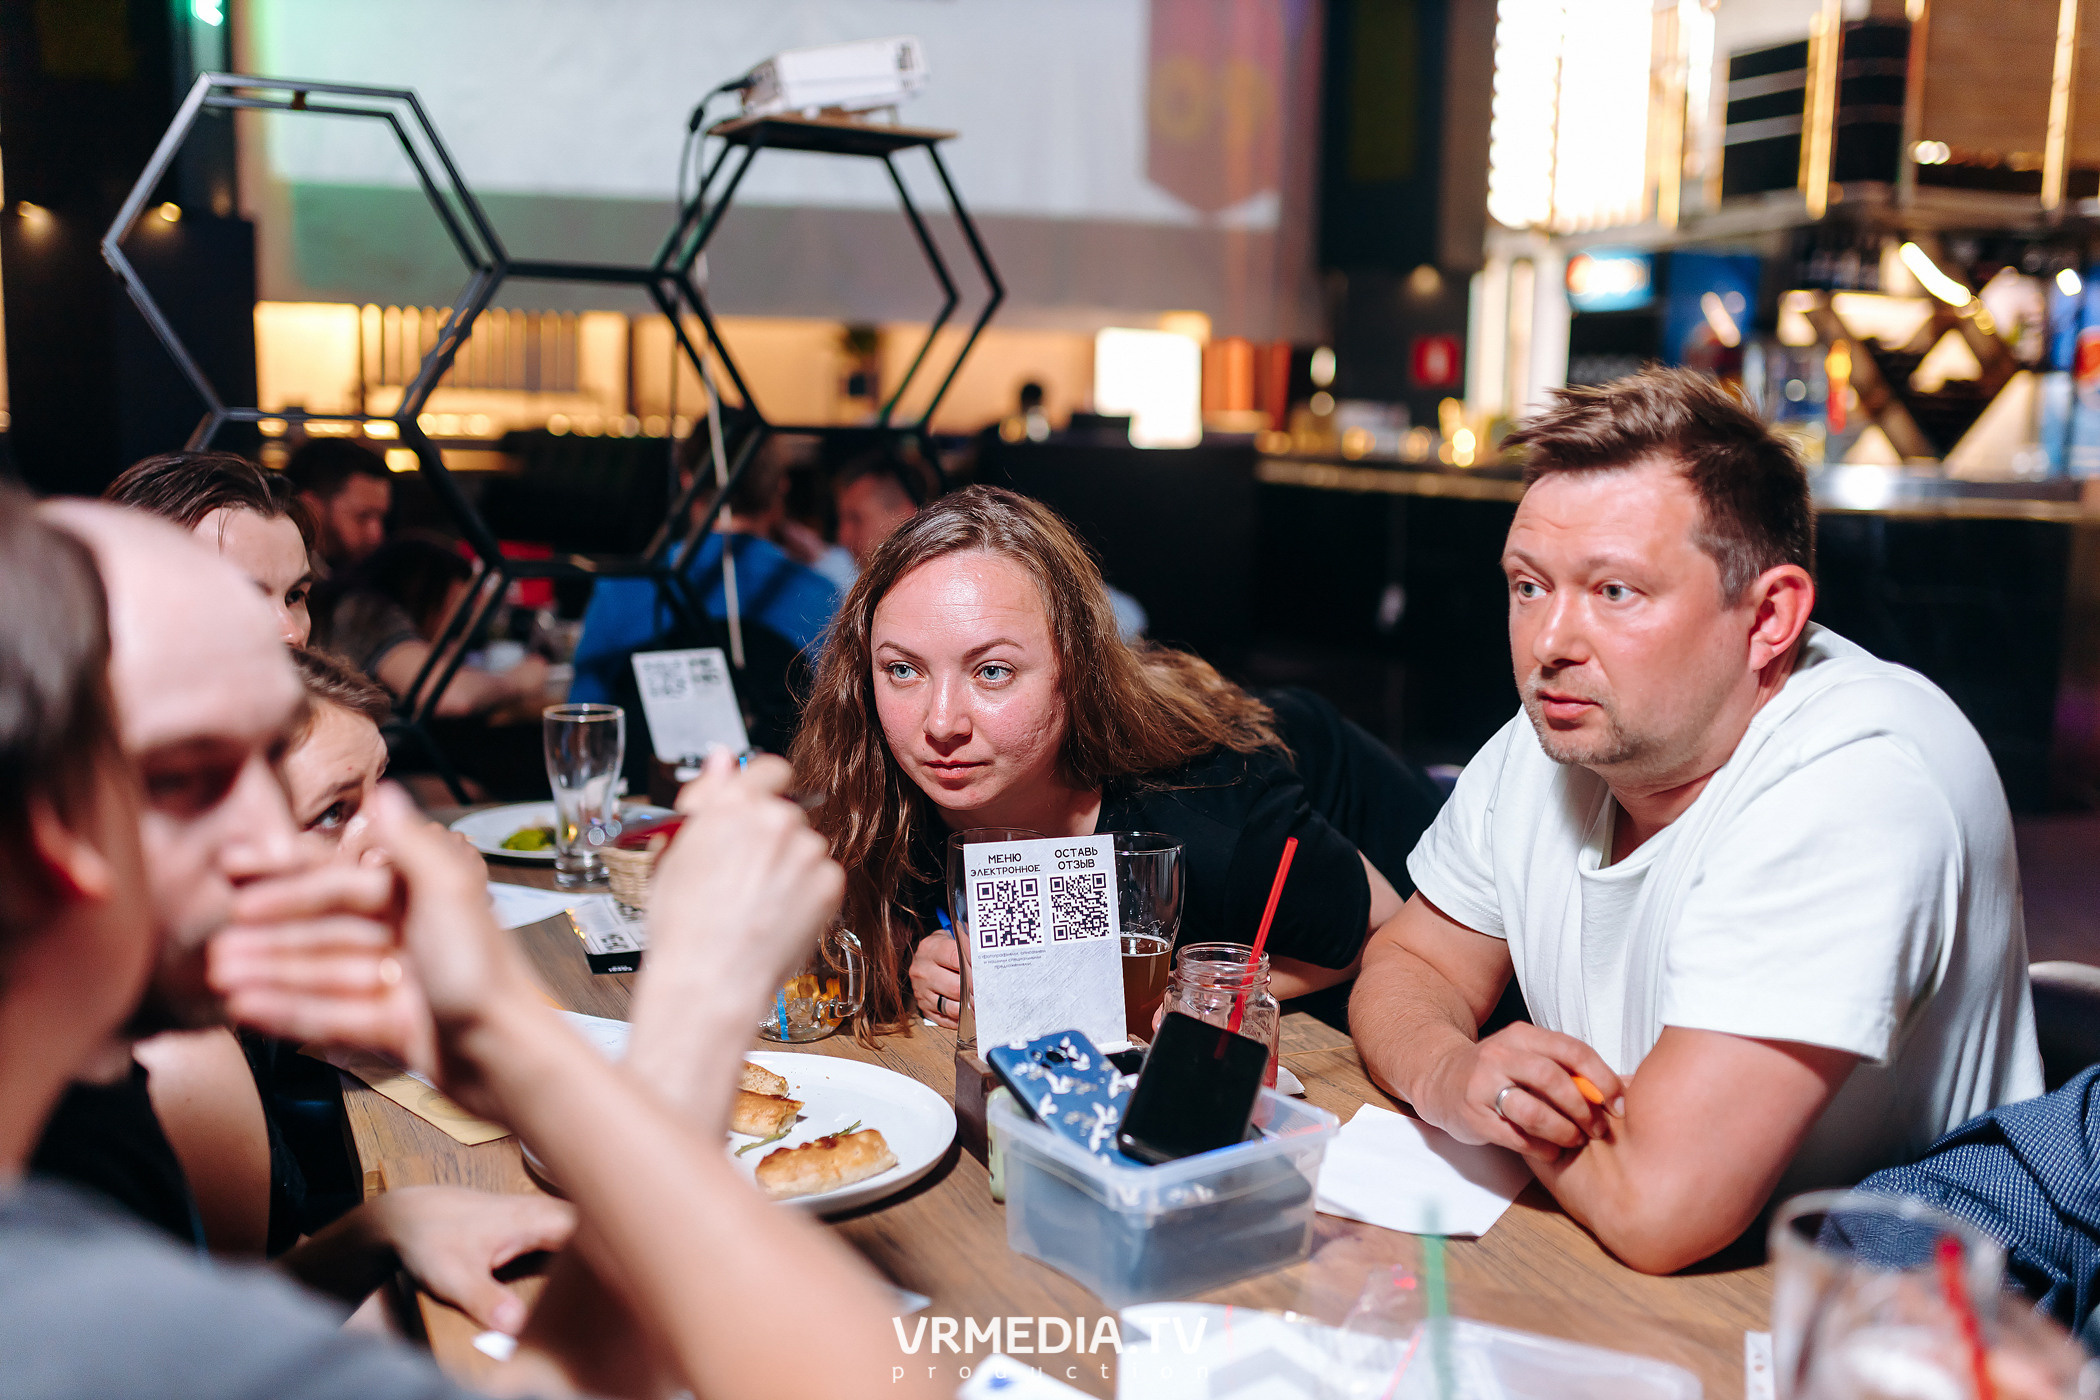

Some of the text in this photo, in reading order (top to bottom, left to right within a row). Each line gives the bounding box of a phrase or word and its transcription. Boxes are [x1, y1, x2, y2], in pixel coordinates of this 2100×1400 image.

[1054, 847, 1099, 858] ОСТАВЬ
[988, 853, 1022, 864] МЕНЮ
[1057, 859, 1095, 870] ОТЗЫВ
[970, 864, 1041, 877] ЭЛЕКТРОННОЕ
